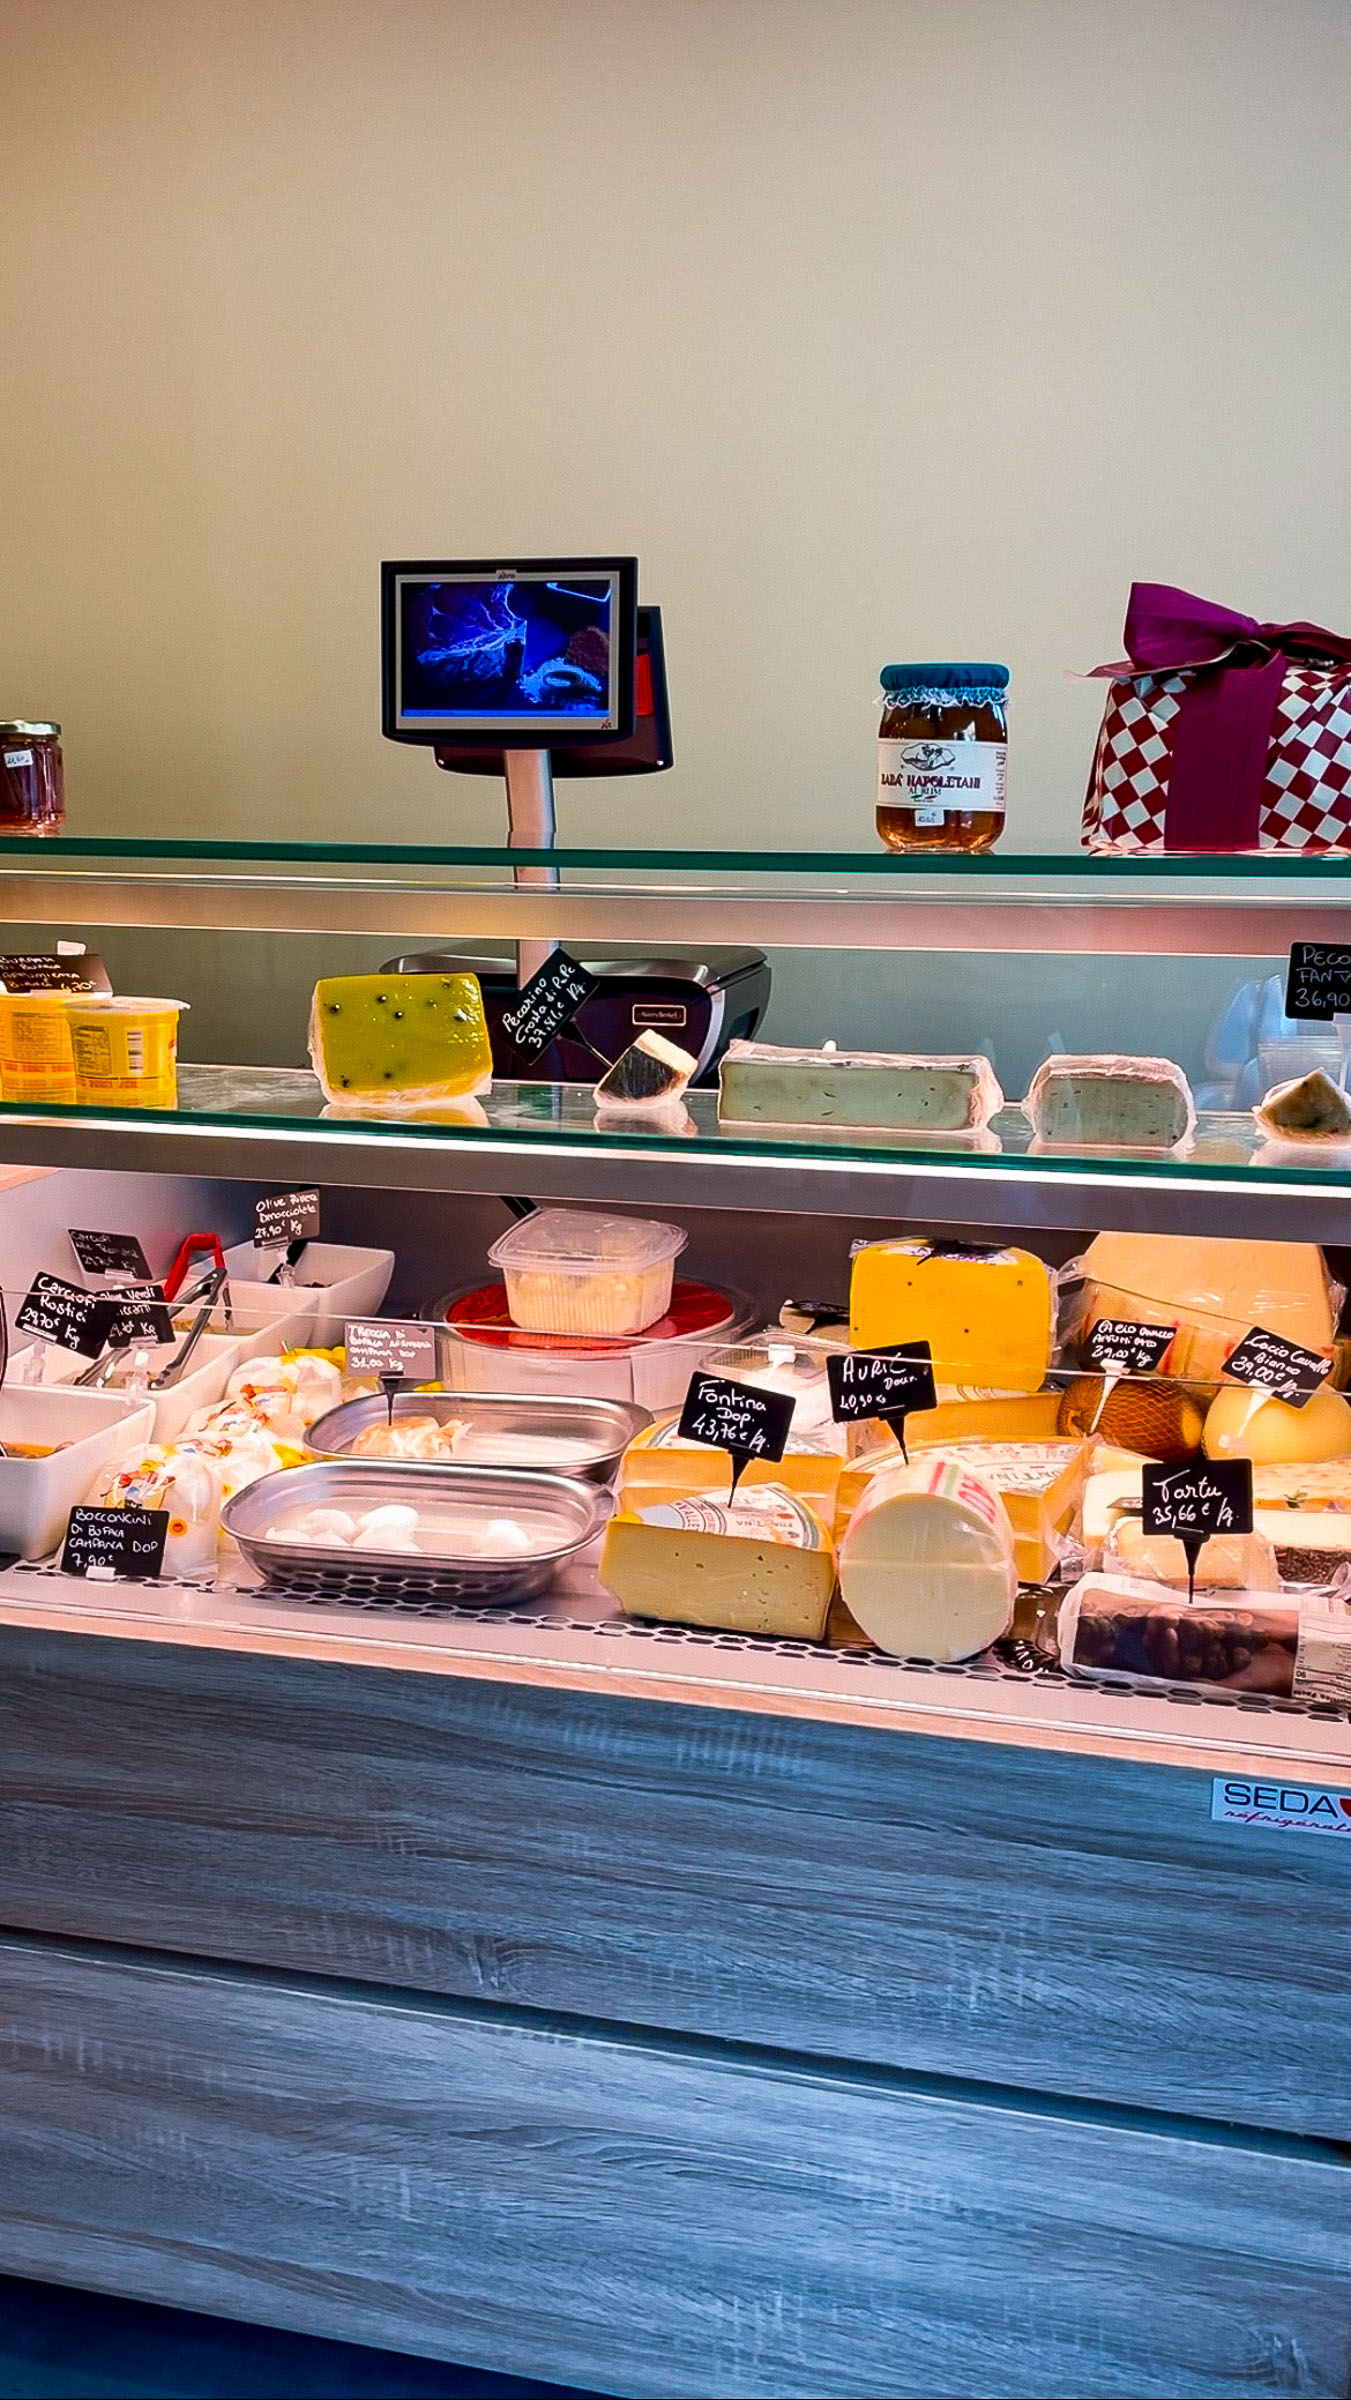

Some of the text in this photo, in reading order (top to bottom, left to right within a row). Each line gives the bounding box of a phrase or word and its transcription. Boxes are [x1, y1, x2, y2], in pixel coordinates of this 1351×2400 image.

[698, 1379, 767, 1411] Fontina
[1152, 1469, 1222, 1502] Tartu
[133, 1540, 158, 1553] DOP
[1224, 1782, 1338, 1819] SEDA
